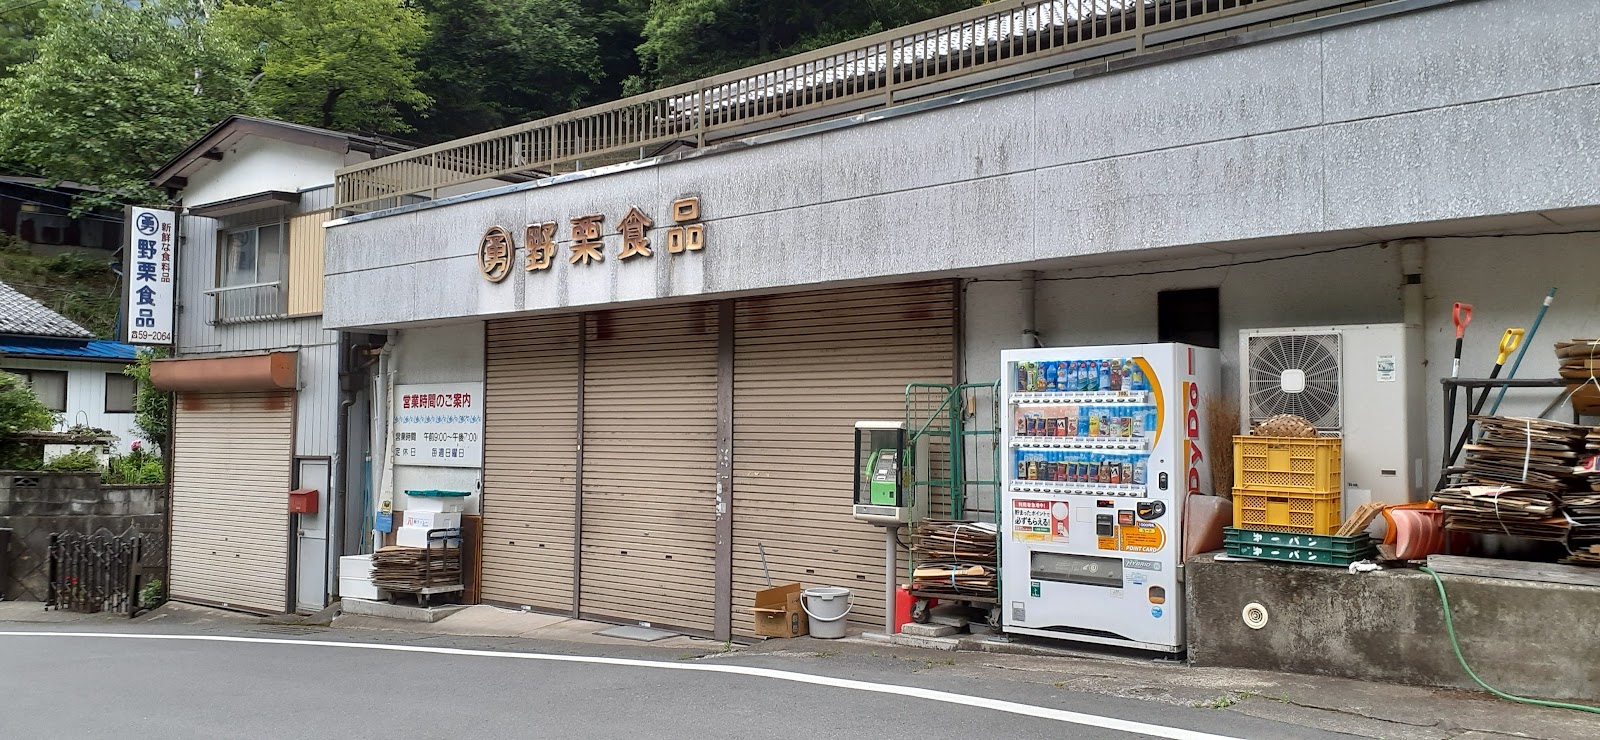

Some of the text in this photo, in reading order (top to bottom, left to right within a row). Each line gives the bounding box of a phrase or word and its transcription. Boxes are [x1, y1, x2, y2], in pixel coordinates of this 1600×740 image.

[525, 196, 706, 272] 野栗食品
[160, 222, 172, 283] 新鮮な食料品
[135, 238, 158, 328] 野栗食品
[138, 330, 171, 341] 59-2064
[402, 392, 471, 409] 営業時間のご案内
[395, 432, 416, 442] 営業時間
[395, 447, 465, 458] 定休日 毎週日曜日
